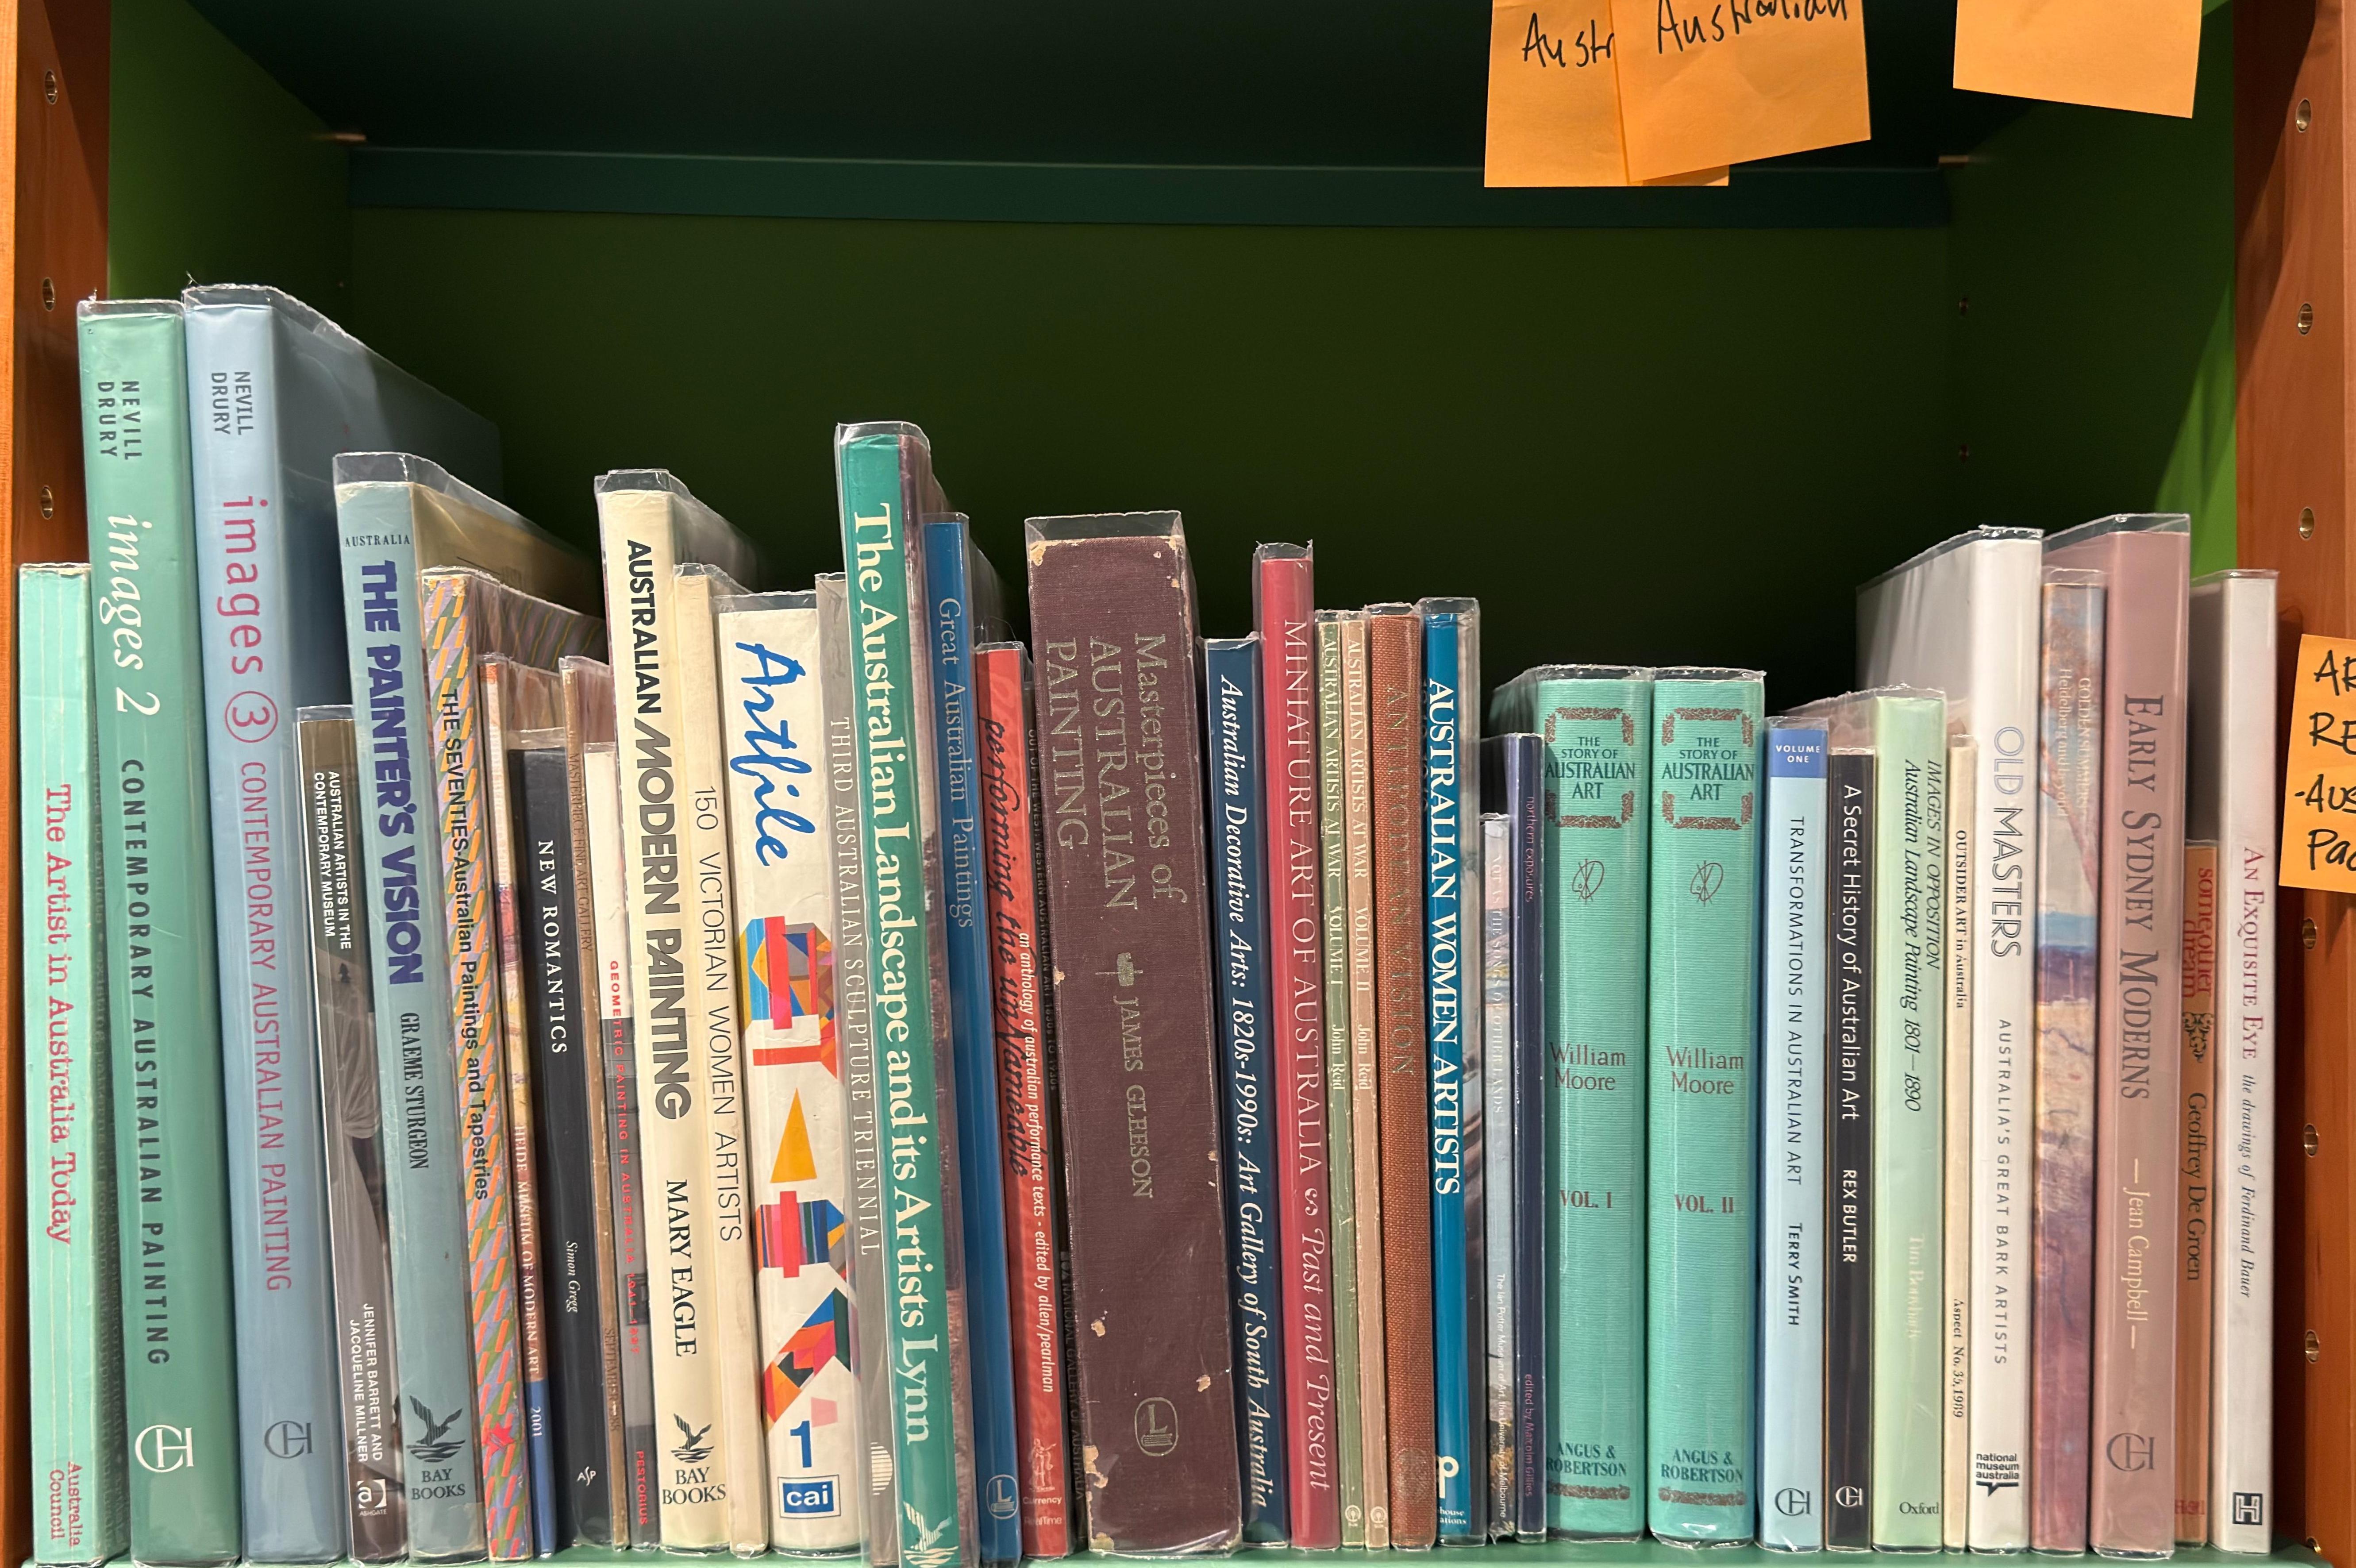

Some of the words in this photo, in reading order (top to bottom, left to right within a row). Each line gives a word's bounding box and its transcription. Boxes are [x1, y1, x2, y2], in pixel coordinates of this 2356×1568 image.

[98, 381, 117, 457] DRURY
[122, 381, 142, 460] NEVILL
[345, 535, 411, 546] AUSTRALIA
[854, 502, 894, 592] The
[100, 515, 153, 670] images
[362, 560, 400, 632] THE
[627, 539, 661, 714] AUSTRALIAN
[115, 687, 161, 716] 2
[860, 600, 905, 818] Australian
[1324, 638, 1340, 739] AUSTRALIAN
[367, 644, 417, 837] PAINTER'S
[730, 642, 816, 866] Artfile
[1221, 675, 1246, 795] Australian
[1284, 620, 1312, 827] MINIATURE
[1679, 750, 1717, 759] STORY
[1721, 750, 1738, 760] OF
[1697, 737, 1720, 747] THE
[1776, 745, 1821, 753] VOLUME
[2124, 694, 2164, 793] EARLY
[1326, 746, 1340, 812] ARTISTS
[1429, 678, 1456, 898] AUSTRALIAN
[1662, 763, 1754, 780] AUSTRALIAN
[1690, 783, 1724, 800] ART
[1844, 785, 1860, 798] A
[1994, 726, 2025, 795] OLD
[46, 784, 71, 842] The
[315, 772, 331, 877] CONTEMPORARY
[329, 771, 344, 849] AUSTRALIAN
[634, 717, 680, 914] MODERN
[1904, 759, 1922, 843] Australian
[1926, 760, 1941, 830] IMAGES
[1327, 819, 1340, 838] AT
[1328, 843, 1341, 878] WAR
[1843, 805, 1861, 866] Secret
[1928, 836, 1941, 856] IN
[122, 759, 154, 999] CONTEMPORARY
[335, 853, 348, 905] ARTISTS
[538, 841, 557, 895] NEW
[1225, 803, 1250, 922] Decorative
[1290, 839, 1314, 906] ART
[1901, 848, 1921, 937] Landscape
[1956, 830, 1967, 904] OUTSIDER
[1991, 807, 2023, 958] MASTERS
[2122, 810, 2162, 932] SYDNEY
[47, 852, 72, 944] Artist
[322, 881, 335, 936] MUSEUM
[339, 909, 349, 921] IN
[381, 845, 423, 984] VISION
[1788, 817, 1805, 996] TRANSFORMATIONS
[1836, 874, 1861, 946] History
[1926, 864, 1941, 970] OPPOSITION
[1956, 907, 1967, 936] ART
[340, 925, 351, 949] THE
[874, 822, 917, 1042] Landscape
[1019, 933, 1032, 948] an
[1230, 929, 1253, 987] Arts:
[1292, 918, 1316, 963] OF
[1329, 907, 1343, 973] VOLUME
[1842, 952, 1862, 974] of
[1956, 939, 1966, 952] in
[49, 954, 72, 986] in
[543, 906, 567, 1054] ROMANTICS
[1020, 953, 1036, 1015] anthology
[1432, 912, 1457, 1045] WOMEN
[1900, 942, 1921, 1012] Painting
[1955, 954, 1967, 1009] Australia
[647, 928, 691, 1120] PAINTING
[1021, 1019, 1039, 1032] of
[1113, 996, 1143, 1072] JAMES
[1331, 1024, 1344, 1054] John
[1788, 1004, 1803, 1022] IN
[1842, 979, 1861, 1082] Australian
[2119, 949, 2160, 1099] MODERNS
[49, 996, 75, 1143] Australia
[400, 1013, 423, 1080] GRAEME
[1025, 1036, 1043, 1099] australian
[1232, 997, 1259, 1144] 1820s-1990s:
[1294, 976, 1322, 1175] AUSTRALIA
[1332, 1063, 1345, 1090] Reid
[1666, 1045, 1744, 1070] William
[133, 1018, 162, 1202] AUSTRALIAN
[887, 1050, 928, 1128] and
[1671, 1071, 1734, 1094] Moore
[1787, 1031, 1802, 1143] AUSTRALIAN
[1842, 1088, 1860, 1120] Art
[2242, 1074, 2256, 1094] the
[405, 1085, 429, 1169] STURGEON
[1024, 1104, 1044, 1181] performance
[1126, 1084, 1153, 1198] GLEESON
[1433, 1053, 1460, 1194] ARTISTS
[2182, 1093, 2207, 1179] Geoffrey
[2238, 1099, 2256, 1159] drawings
[892, 1135, 928, 1179] its
[1238, 1152, 1261, 1194] Art
[1787, 1152, 1802, 1185] ART
[1843, 1170, 1858, 1199] REX
[1996, 1154, 2010, 1216] GREAT
[2237, 1164, 2255, 1180] of
[47, 1152, 76, 1245] Today
[666, 1179, 692, 1258] MARY
[1032, 1186, 1046, 1217] texts
[2122, 1186, 2150, 1229] Jean
[2188, 1185, 2206, 1213] De
[2240, 1186, 2255, 1253] Ferdinand
[566, 1241, 578, 1275] Simon
[894, 1186, 934, 1327] Artists
[1035, 1231, 1049, 1273] edited
[1236, 1202, 1264, 1283] Gallery
[1301, 1228, 1325, 1294] Past
[1843, 1204, 1858, 1262] BUTLER
[1995, 1225, 2009, 1276] BARK
[2187, 1218, 2206, 1281] Groen
[142, 1223, 170, 1364] PAINTING
[566, 1280, 581, 1313] Gregg
[1034, 1276, 1050, 1290] by
[1238, 1293, 1267, 1320] of
[2121, 1235, 2149, 1321] Campbell
[2239, 1257, 2255, 1298] Bauer
[363, 1303, 377, 1366] JENNIFER
[671, 1266, 697, 1357] EAGLE
[1036, 1295, 1054, 1392] allen/pearlman
[1305, 1303, 1328, 1364] and
[1994, 1285, 2009, 1365] ARTISTS
[349, 1320, 365, 1400] JACQUELINE
[1244, 1322, 1269, 1388] South
[367, 1371, 381, 1429] BARRETT
[896, 1335, 938, 1445] Lynn
[356, 1405, 368, 1461] MILLNER
[372, 1433, 383, 1460] AND
[1247, 1395, 1273, 1507] Australia
[1307, 1375, 1331, 1491] Present
[1976, 1453, 2017, 1462] national
[50, 1469, 65, 1540] Council
[68, 1461, 83, 1546] Australia
[411, 1484, 466, 1499] BOOKS
[421, 1468, 453, 1483] BAY
[636, 1451, 648, 1524] PESTORIUS
[787, 1485, 829, 1506] cai
[1899, 1501, 1939, 1515] Oxford
[1975, 1471, 2019, 1479] australia
